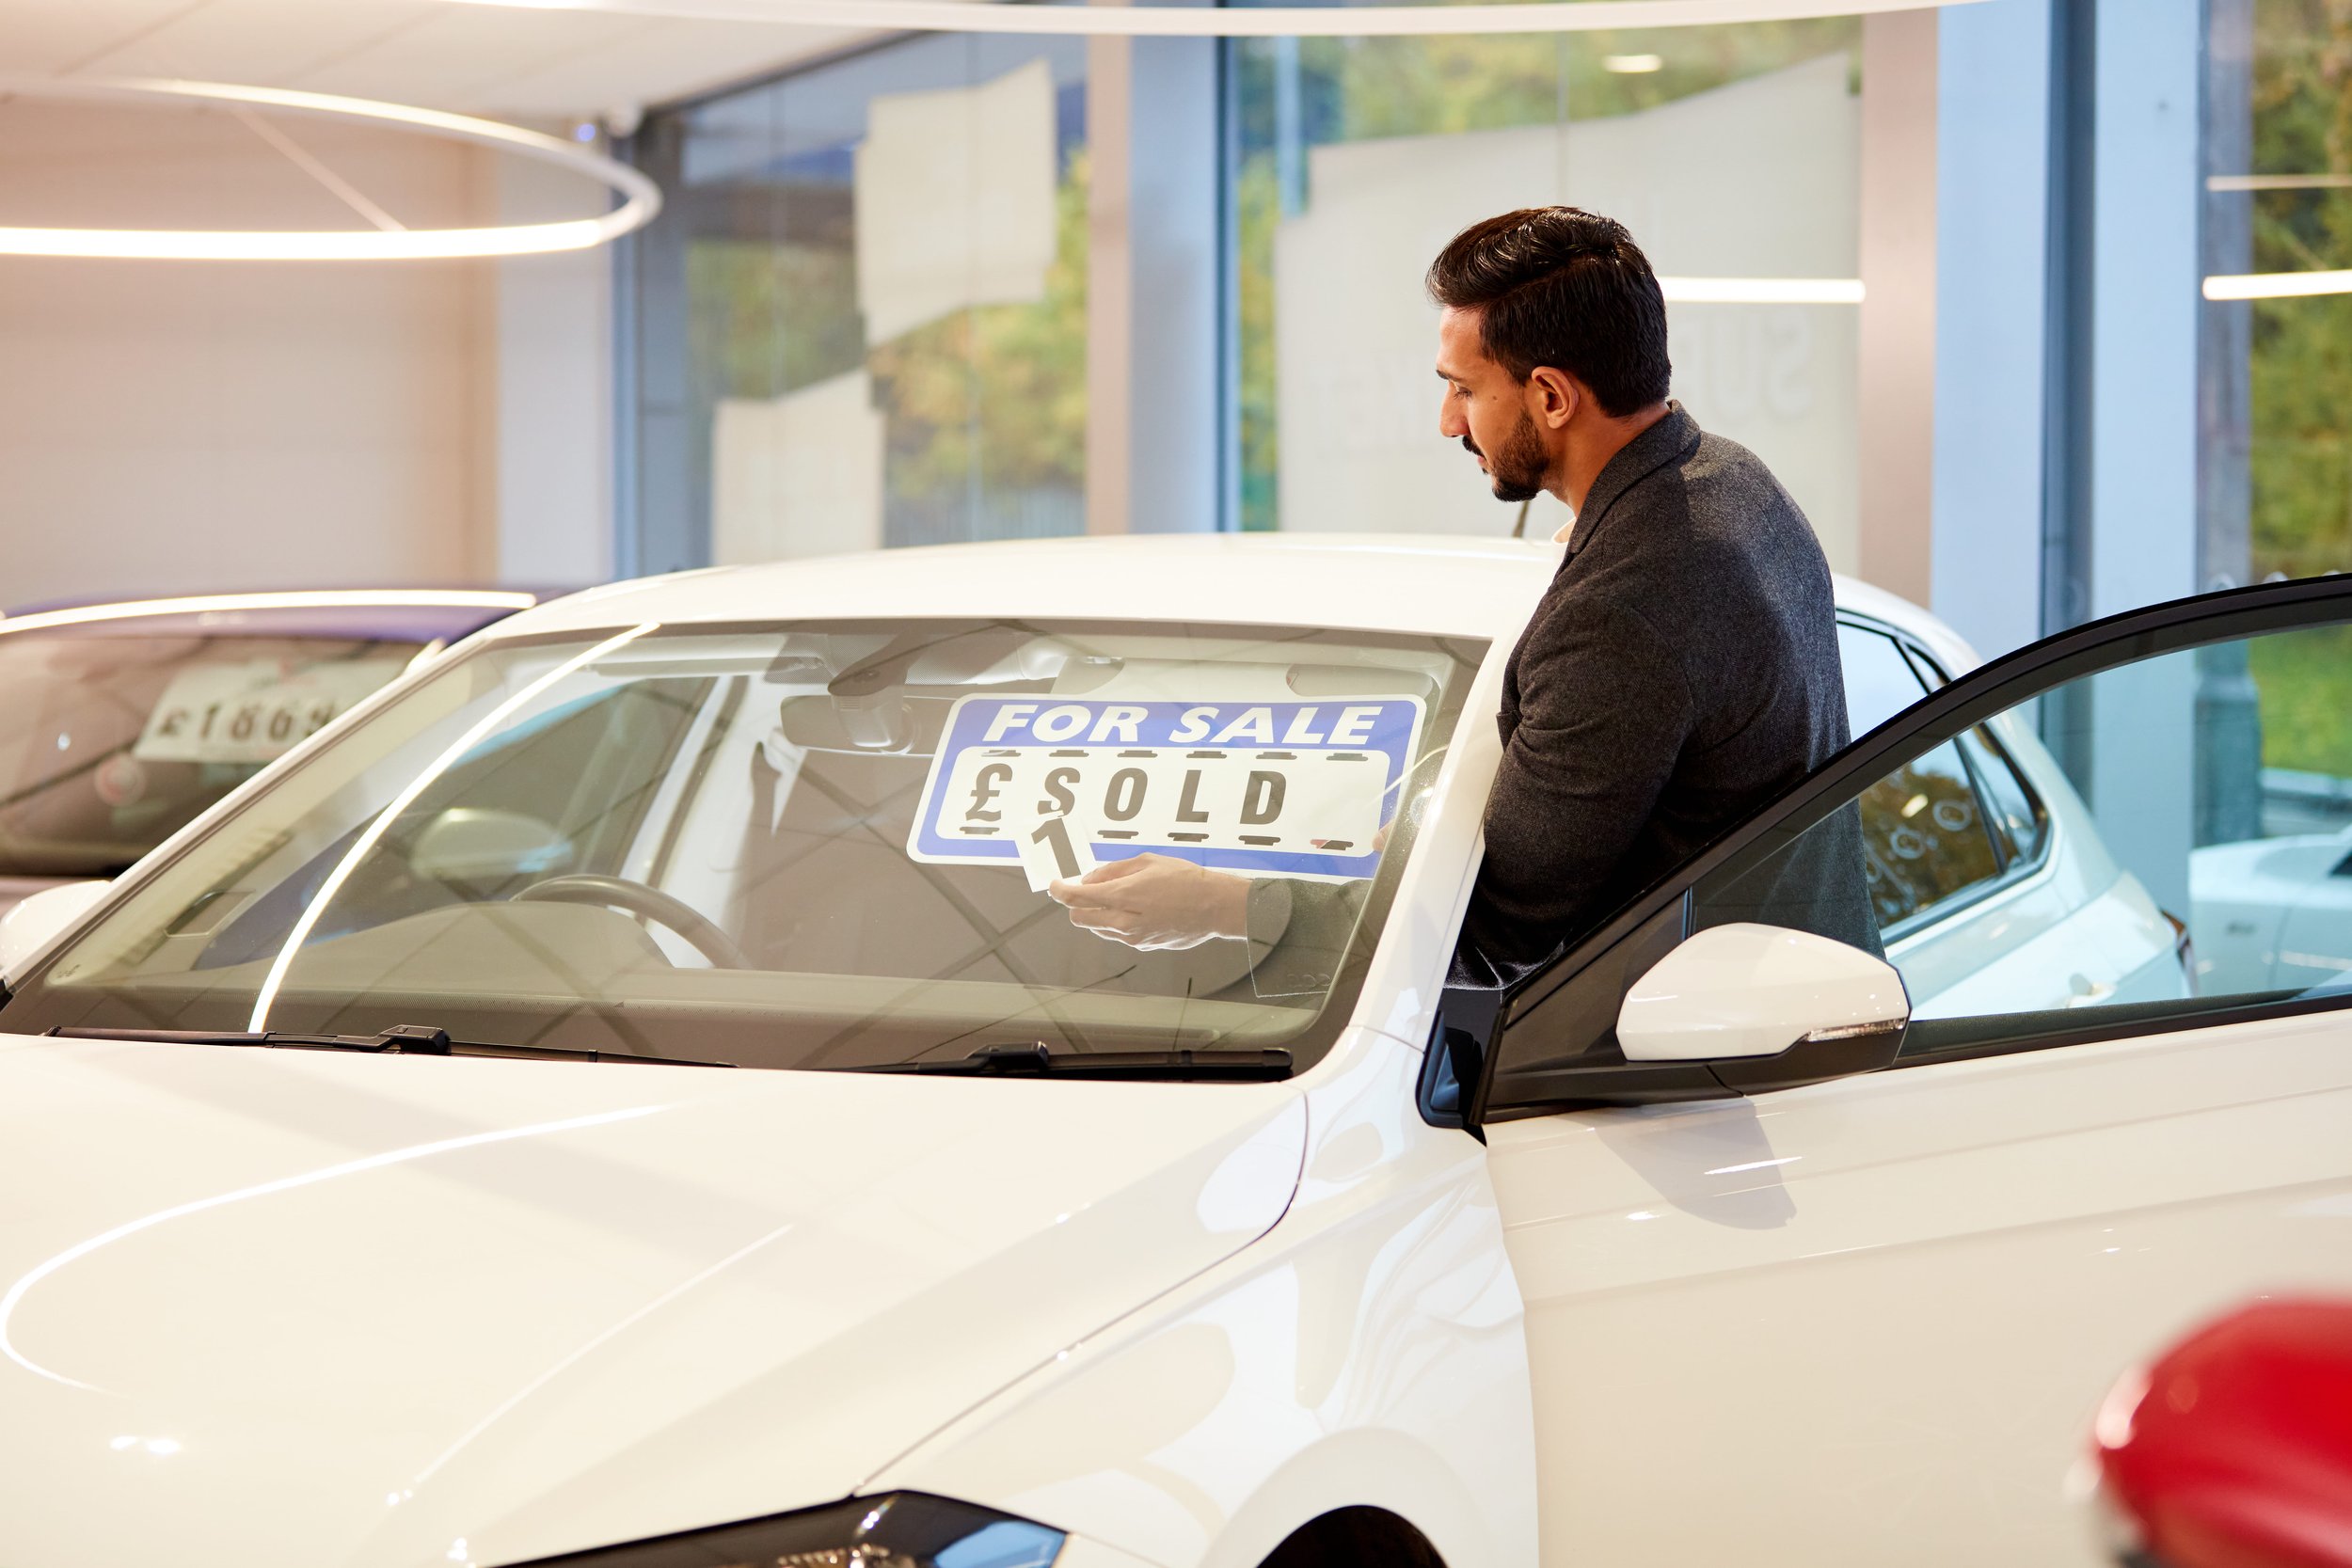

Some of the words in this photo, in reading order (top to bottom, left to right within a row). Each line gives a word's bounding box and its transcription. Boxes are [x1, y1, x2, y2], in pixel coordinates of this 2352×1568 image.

[982, 705, 1150, 743] FOR
[1168, 705, 1383, 745] SALE
[1030, 816, 1082, 879] 1
